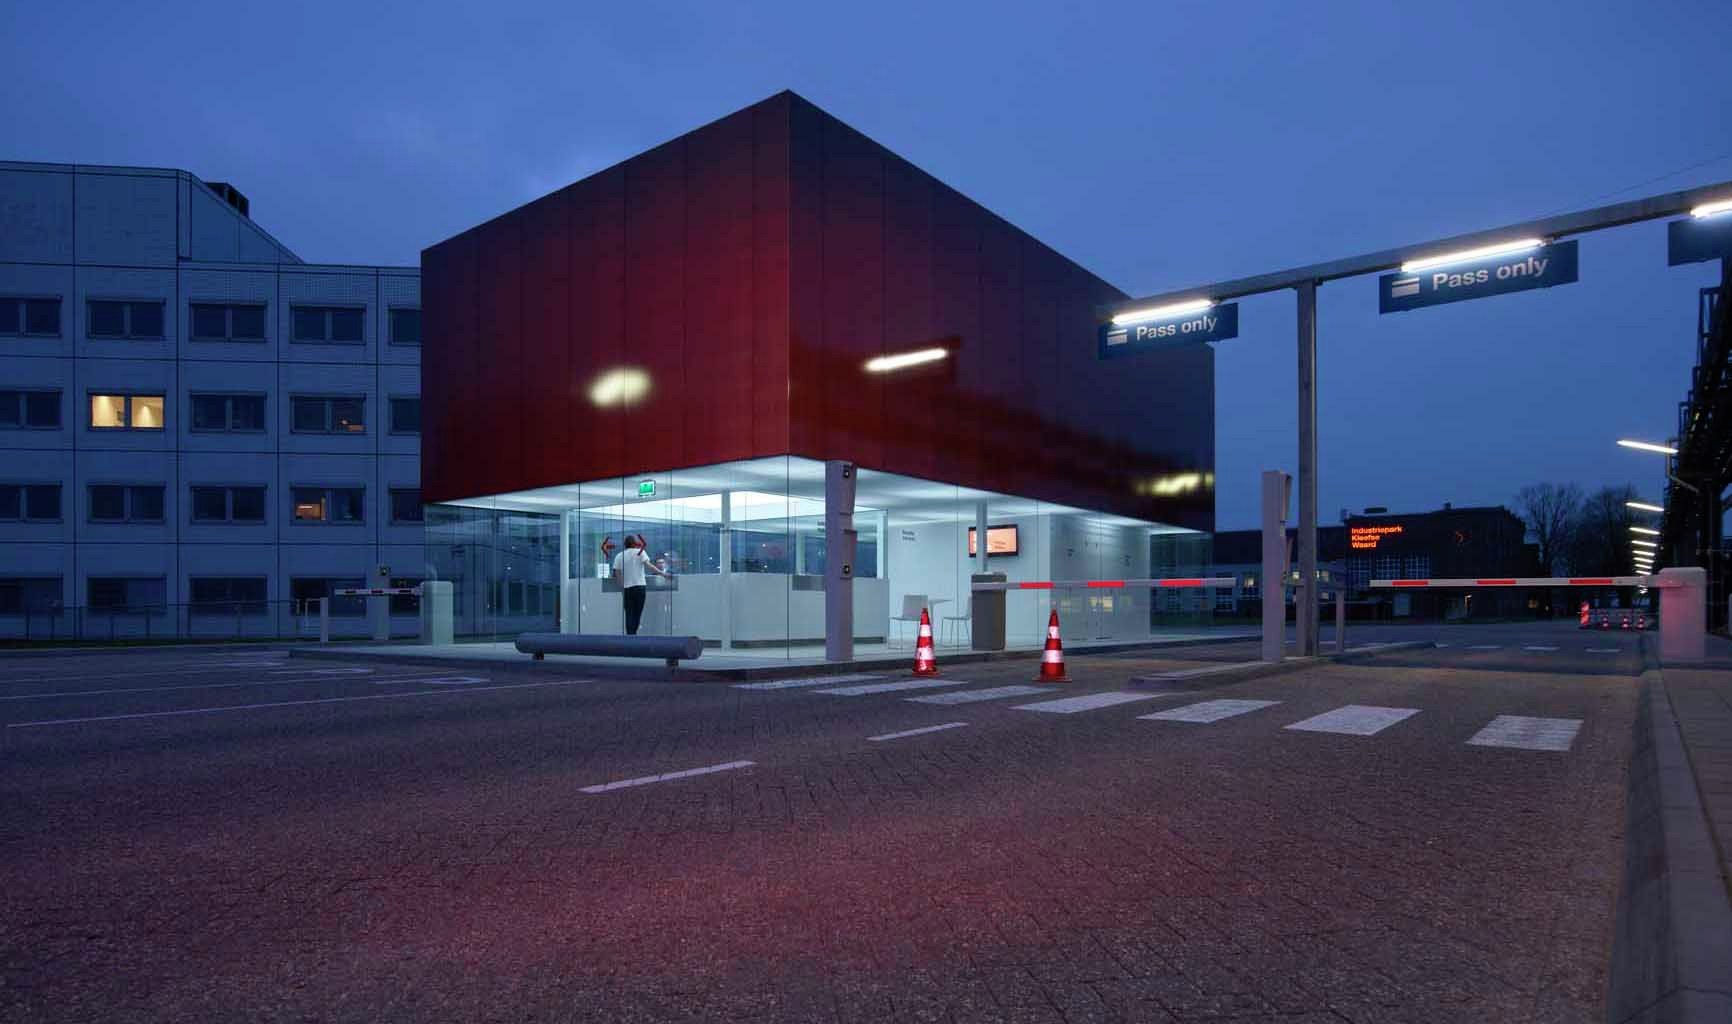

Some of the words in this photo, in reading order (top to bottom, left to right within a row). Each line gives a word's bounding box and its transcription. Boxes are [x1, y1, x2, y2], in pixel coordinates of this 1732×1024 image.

[1433, 270, 1489, 290] Pass
[1496, 256, 1549, 280] only
[1136, 324, 1176, 340] Pass
[1181, 315, 1217, 333] only
[1352, 526, 1402, 534] Industriepark
